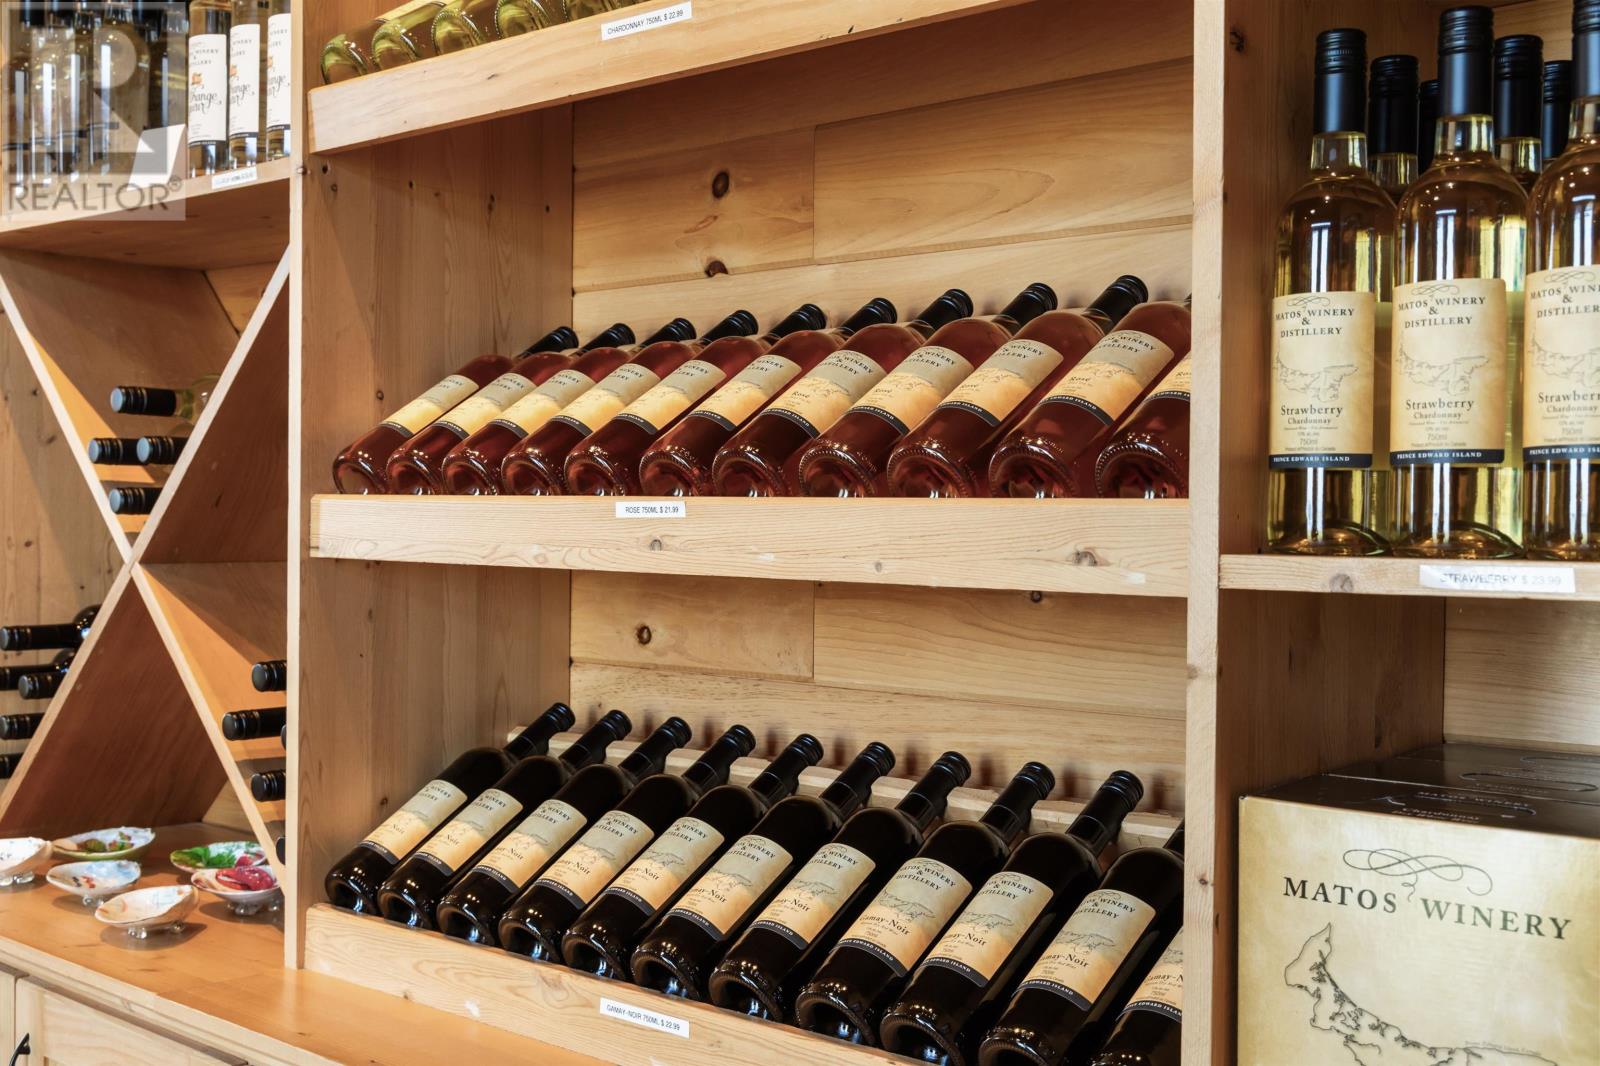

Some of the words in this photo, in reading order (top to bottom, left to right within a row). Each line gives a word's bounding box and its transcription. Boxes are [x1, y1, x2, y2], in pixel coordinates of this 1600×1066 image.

[607, 19, 645, 35] CHARDONNAY
[646, 15, 663, 25] 750ML
[1531, 287, 1561, 299] MATOS
[1569, 284, 1600, 293] WIN
[1562, 294, 1572, 303] &
[1398, 300, 1428, 311] MATOS
[1435, 296, 1486, 305] WINERY
[1429, 306, 1438, 315] &
[1275, 310, 1301, 320] MATOS
[1307, 308, 1354, 317] WINERY
[1302, 317, 1310, 325] &
[1404, 316, 1473, 329] DISTILLERY
[1280, 327, 1342, 338] DISTILLERY
[1011, 344, 1043, 356] WINERY
[1120, 336, 1155, 350] WINERY
[844, 356, 873, 373] WINERY
[925, 351, 956, 365] WINERY
[1280, 404, 1343, 417] Strawberry
[1406, 398, 1475, 411] Strawberry
[1288, 417, 1331, 425] Chardonnay
[1413, 411, 1462, 420] Chardonnay
[625, 506, 640, 514] ROSE
[642, 506, 658, 514] 750ML
[660, 506, 663, 514] $
[664, 506, 679, 514] 21.99
[613, 818, 638, 834] WINERY
[681, 824, 707, 838] WINERY
[748, 843, 776, 859] WINERY
[829, 850, 858, 865] WINERY
[924, 867, 956, 887] WINERY
[1001, 879, 1034, 894] WINERY
[1101, 898, 1136, 913] WINERY
[1283, 876, 1397, 914] MATOS
[1420, 897, 1572, 940] WINERY
[874, 946, 894, 961] ISLAND
[1051, 983, 1074, 995] ISLAND
